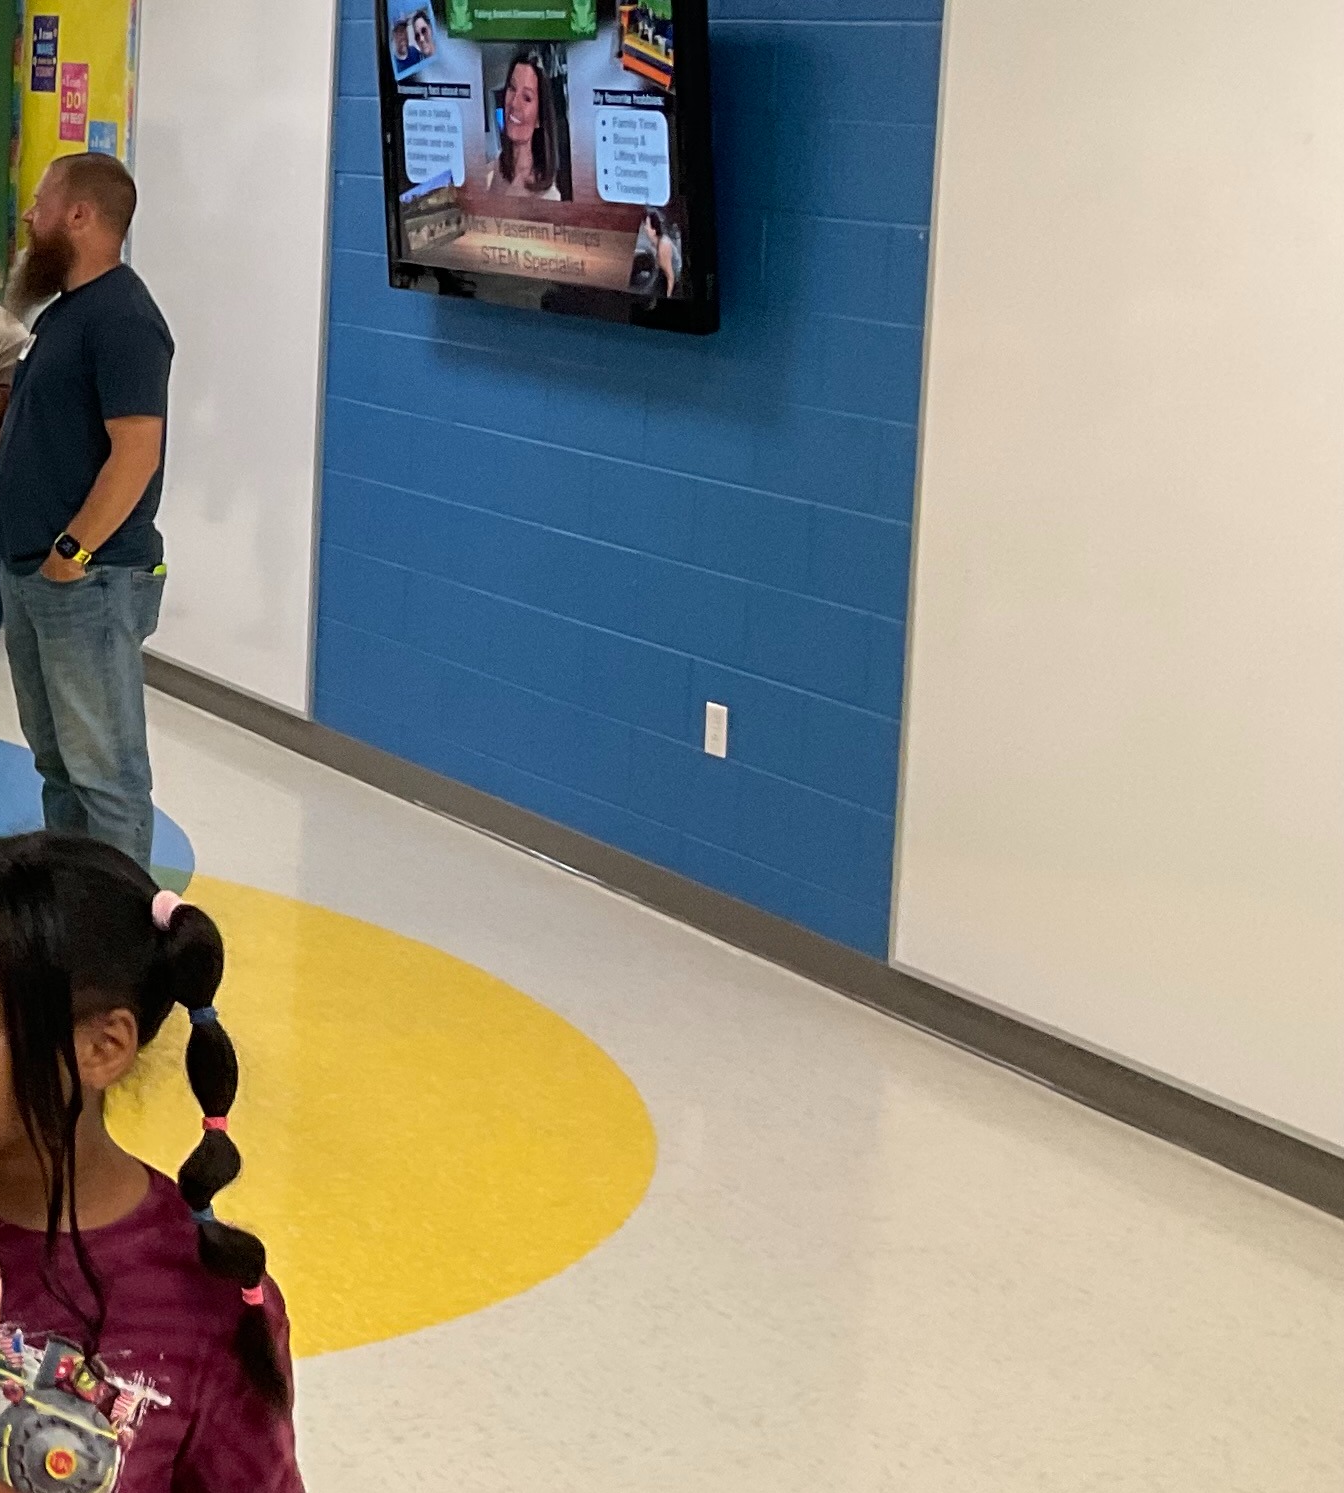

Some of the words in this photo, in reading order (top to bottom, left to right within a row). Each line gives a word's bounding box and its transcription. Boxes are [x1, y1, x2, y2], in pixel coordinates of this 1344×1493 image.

[66, 91, 82, 109] DO
[481, 246, 520, 270] STEM
[523, 251, 587, 277] Specialist
